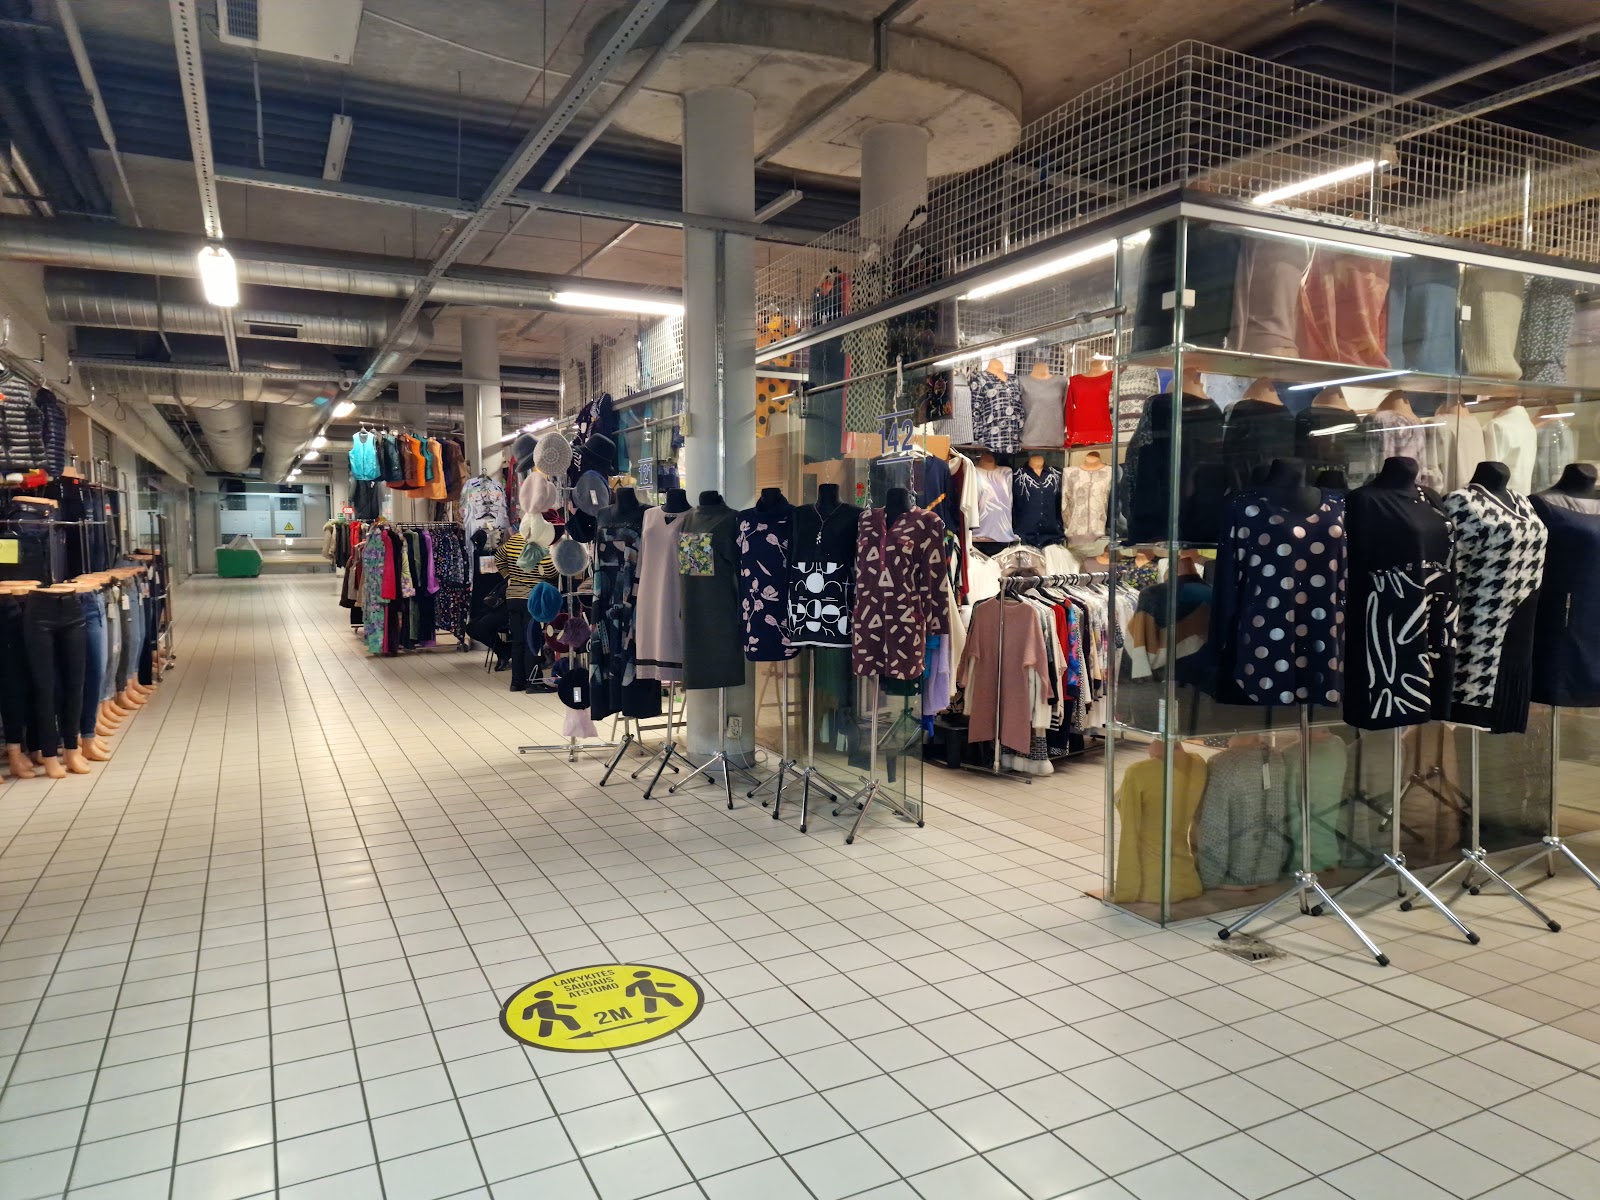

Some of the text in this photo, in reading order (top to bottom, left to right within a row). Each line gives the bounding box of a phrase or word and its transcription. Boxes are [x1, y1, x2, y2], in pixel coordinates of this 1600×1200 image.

[878, 418, 913, 454] 142
[638, 462, 653, 485] 121
[553, 969, 615, 987] LAIKYKITĖS
[563, 977, 614, 992] SAUGAUS
[568, 982, 619, 998] ATSTUMO
[593, 1006, 633, 1025] 2M
